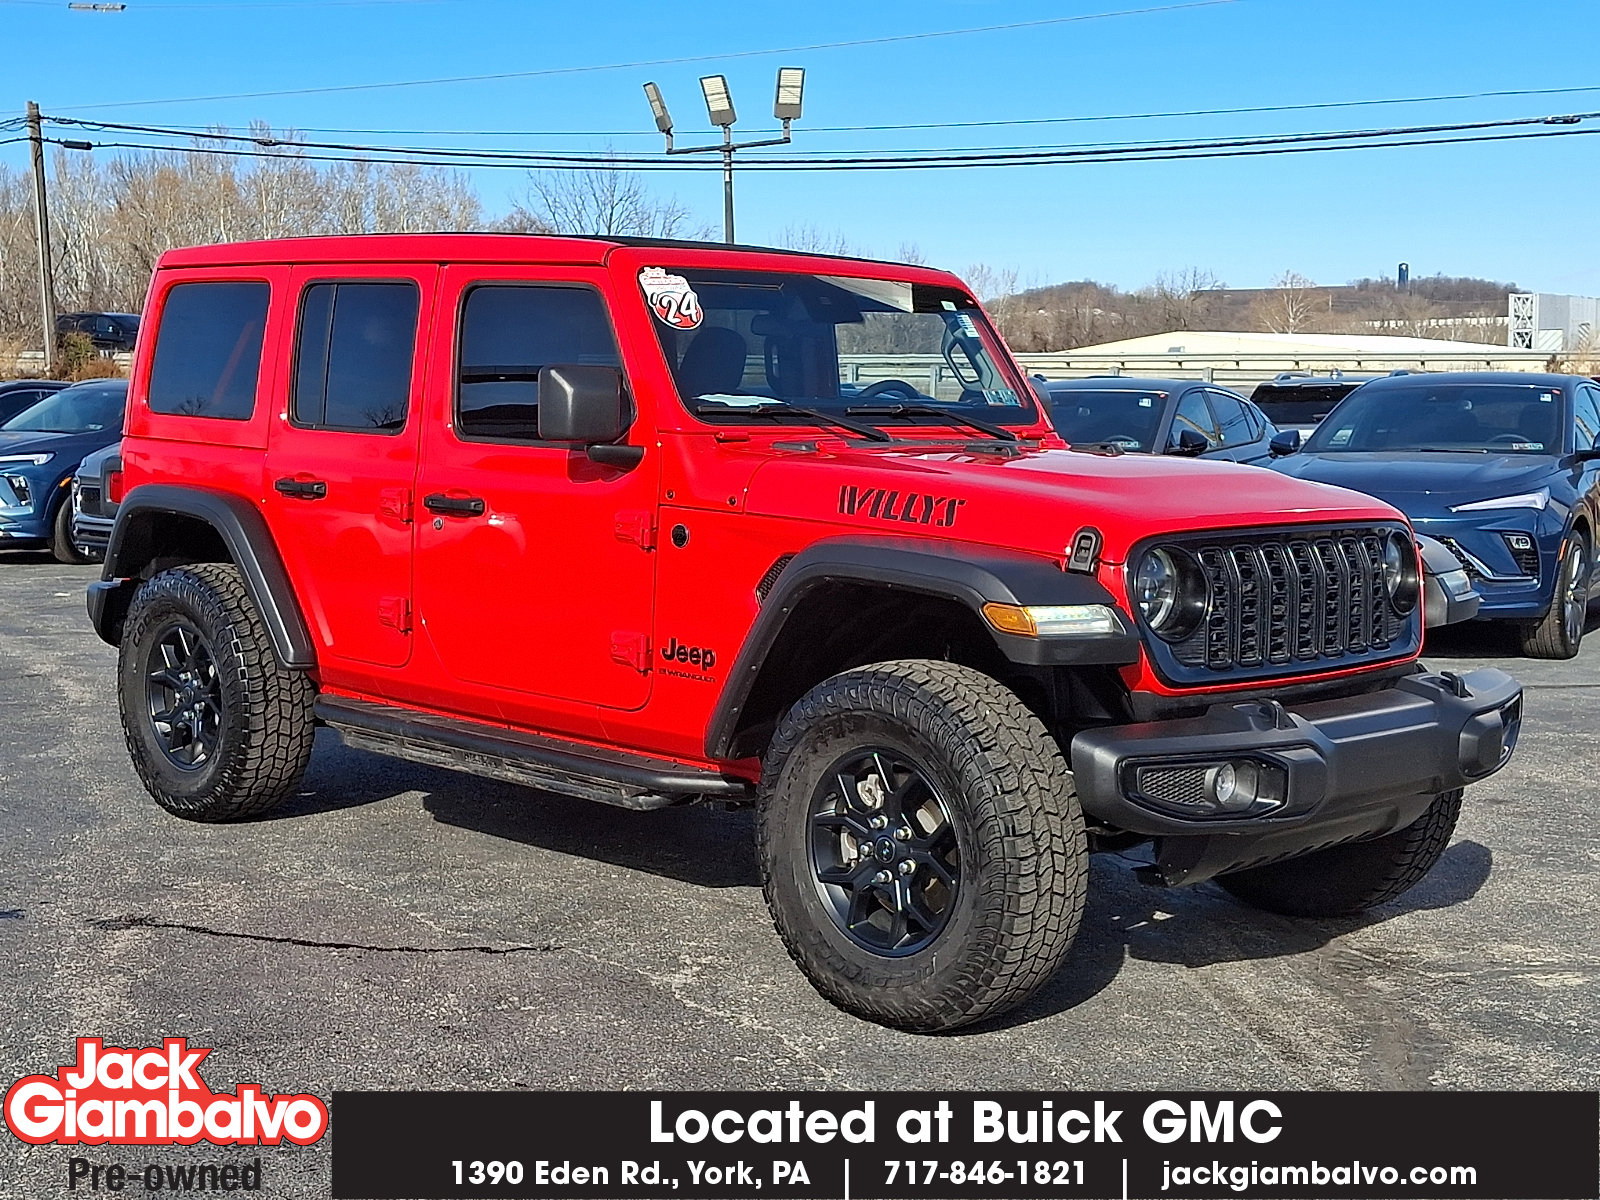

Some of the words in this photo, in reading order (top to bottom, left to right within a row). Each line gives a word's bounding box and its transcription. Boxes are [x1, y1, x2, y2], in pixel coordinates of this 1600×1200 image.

[838, 485, 966, 526] WILLYS
[661, 637, 716, 671] Jeep
[667, 669, 716, 682] WRANGLER
